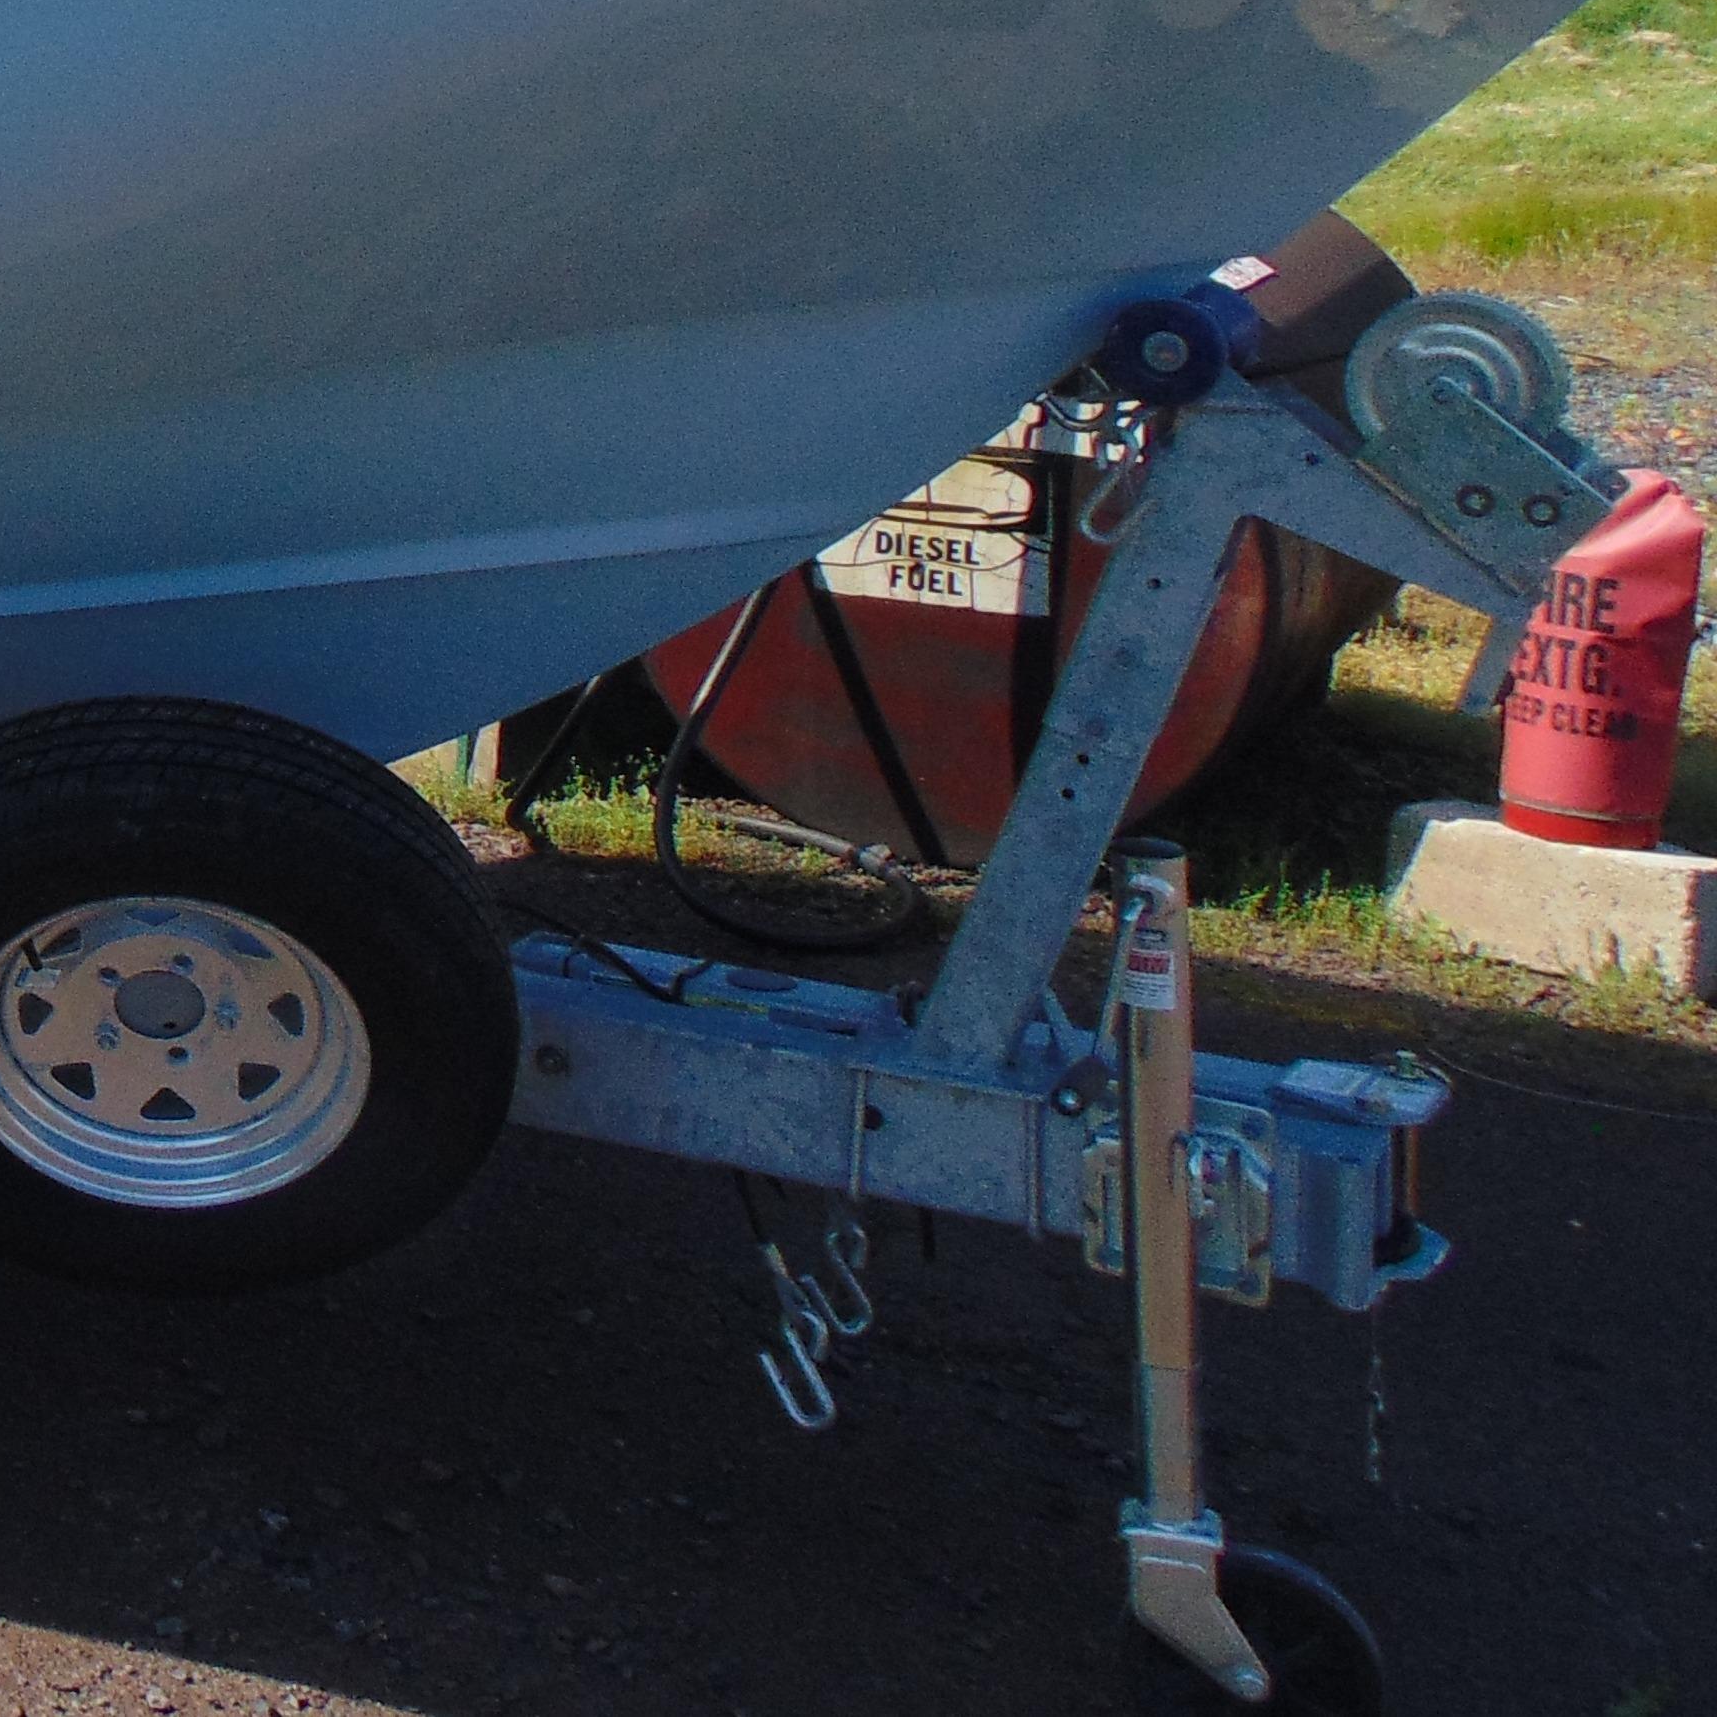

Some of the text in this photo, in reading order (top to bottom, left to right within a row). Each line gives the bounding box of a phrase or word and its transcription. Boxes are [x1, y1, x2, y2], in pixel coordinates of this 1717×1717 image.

[875, 530, 981, 566] DIESEL
[889, 564, 963, 597] FUEL
[1547, 572, 1621, 634] IRE
[1507, 693, 1544, 725] EEP
